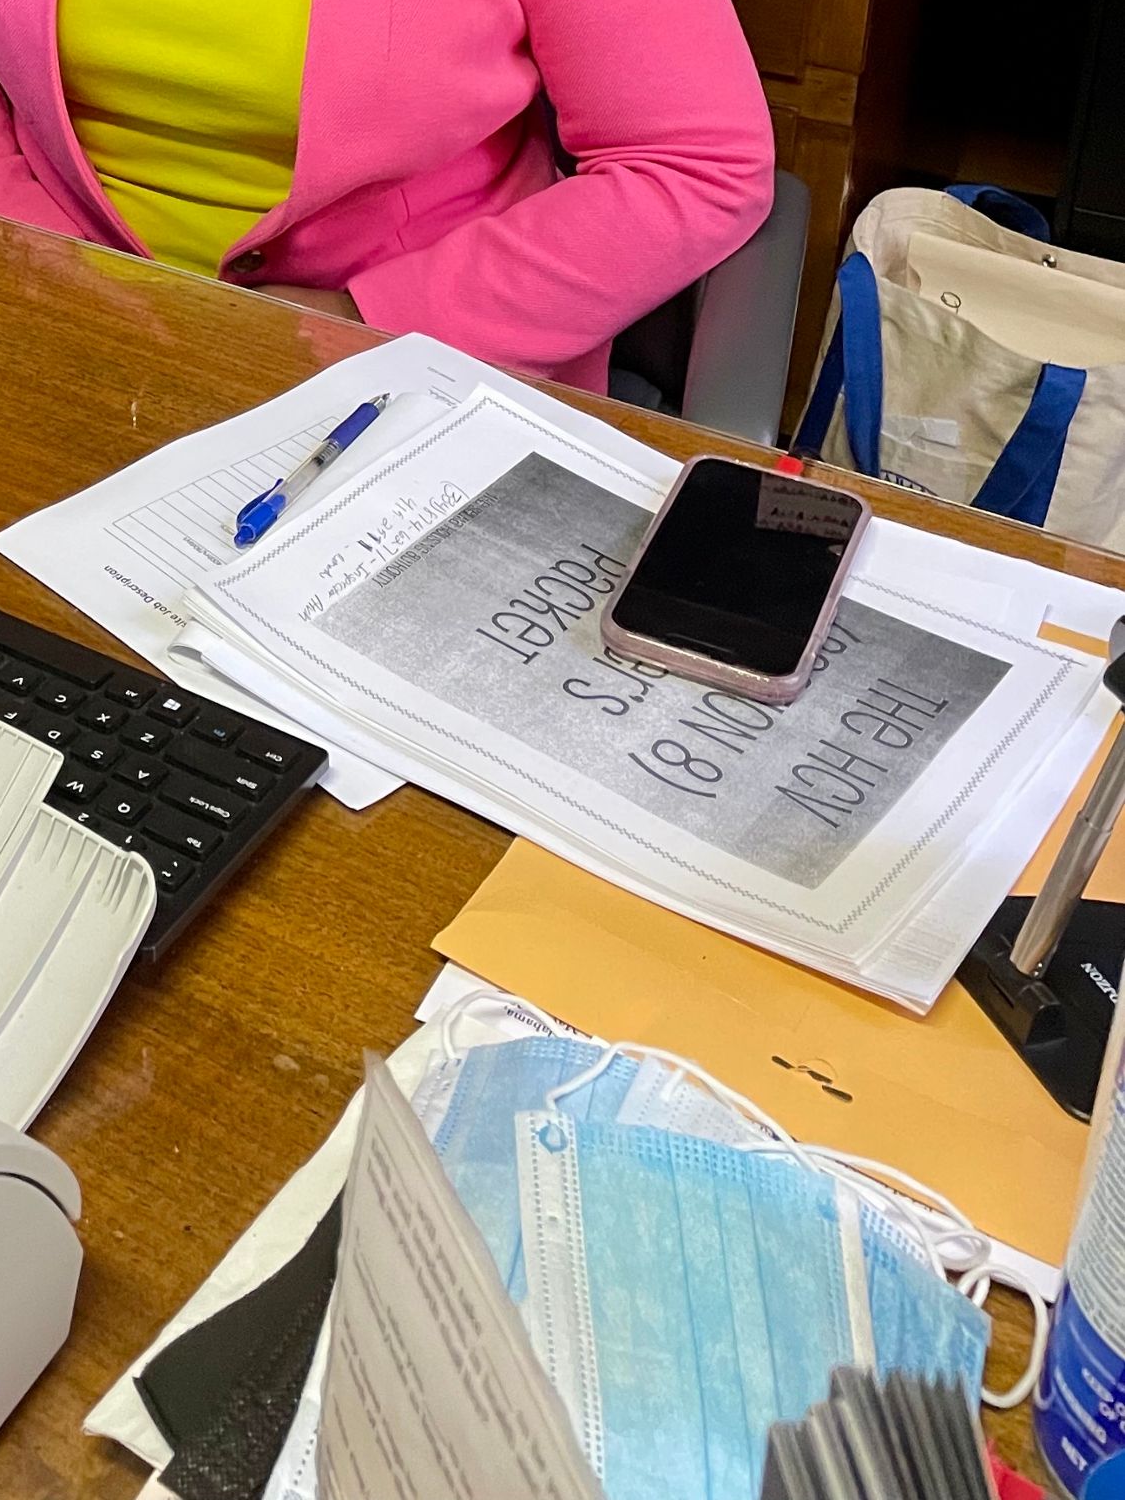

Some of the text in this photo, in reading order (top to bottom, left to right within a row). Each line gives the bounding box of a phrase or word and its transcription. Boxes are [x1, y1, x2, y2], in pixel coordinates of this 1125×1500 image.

[104, 565, 155, 605] Description
[153, 602, 171, 616] Job
[2, 713, 17, 722] F
[97, 714, 110, 722] X
[48, 731, 61, 739] D
[141, 733, 154, 742] Z
[628, 738, 724, 800] 8)
[139, 770, 149, 779] A
[67, 781, 83, 792] W
[773, 739, 889, 829] HCV
[118, 803, 130, 813] Q
[187, 838, 201, 847] Tab
[504, 1004, 554, 1038] labama,
